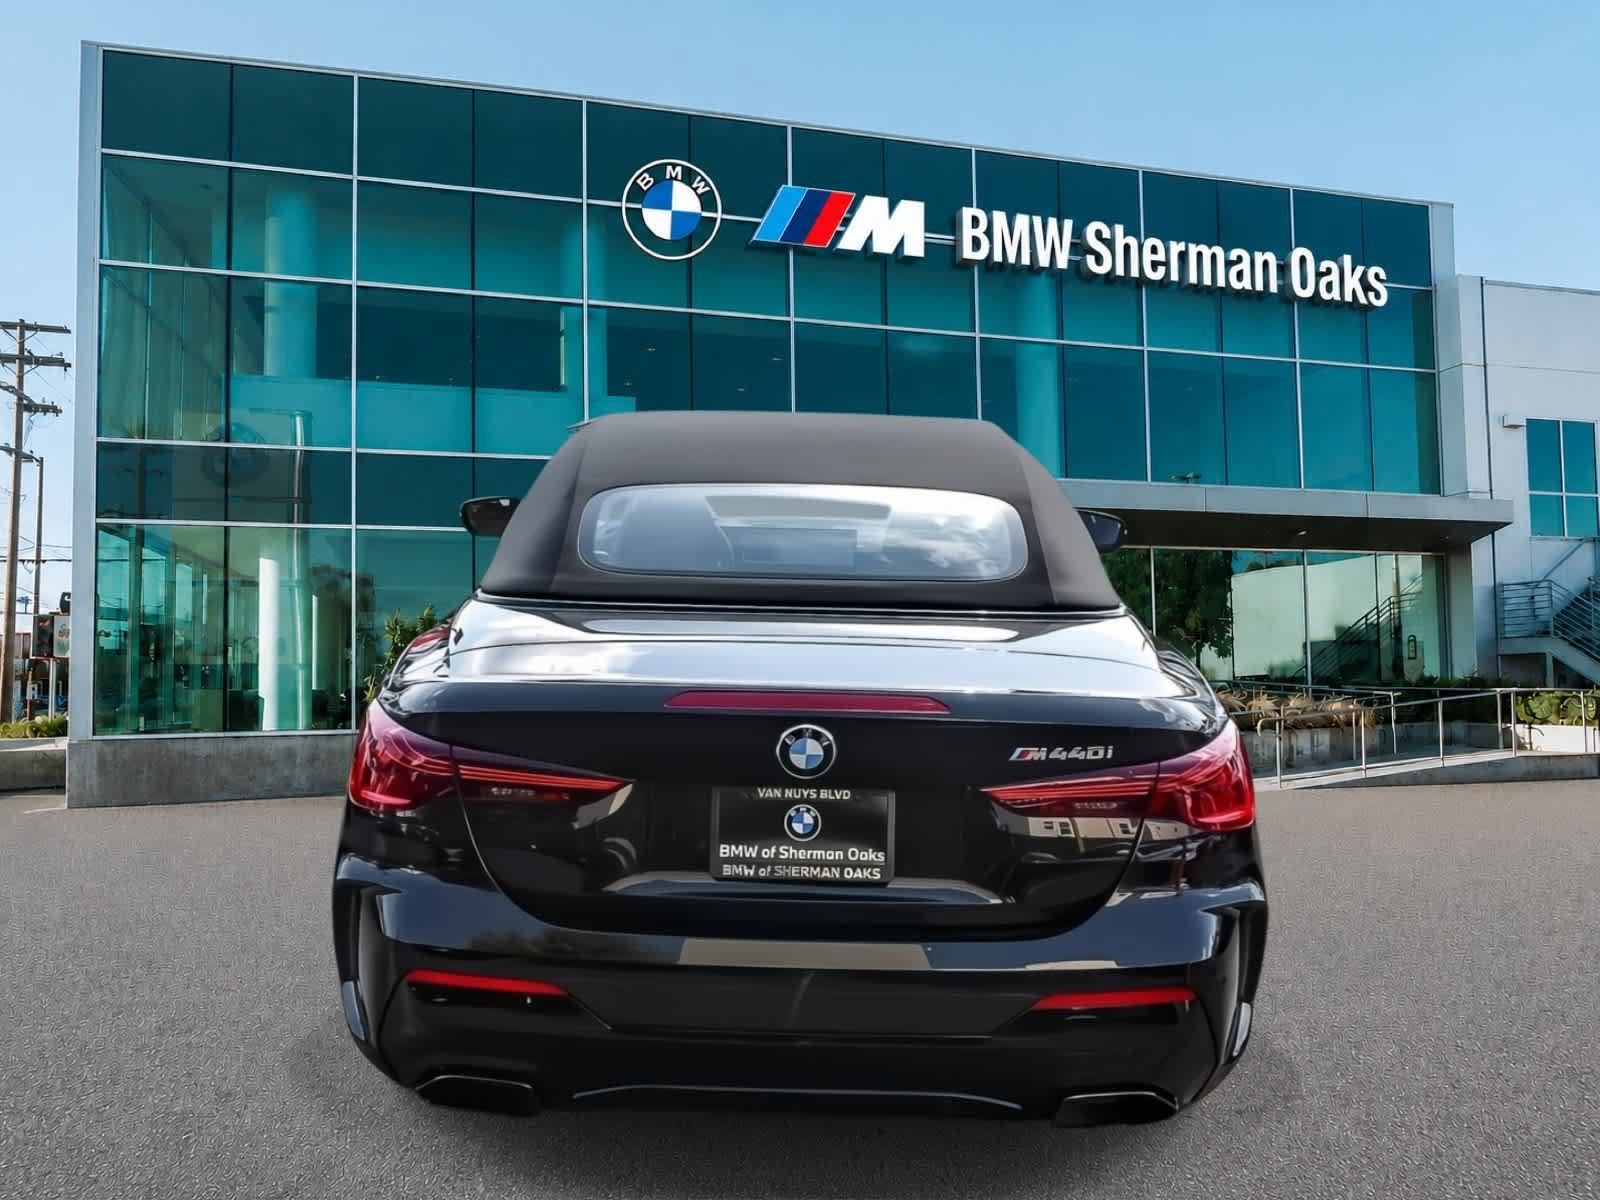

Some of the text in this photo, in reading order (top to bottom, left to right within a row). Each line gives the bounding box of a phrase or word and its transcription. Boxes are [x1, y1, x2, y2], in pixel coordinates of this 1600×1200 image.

[635, 164, 711, 196] BMW
[835, 194, 925, 258] M
[960, 206, 1388, 307] BMW Sherman Oaks
[757, 787, 851, 800] VAN NUYS BLVD
[719, 843, 886, 862] BMW of Sherman Oaks
[722, 864, 881, 880] BMW of SHERMAN OAKS
